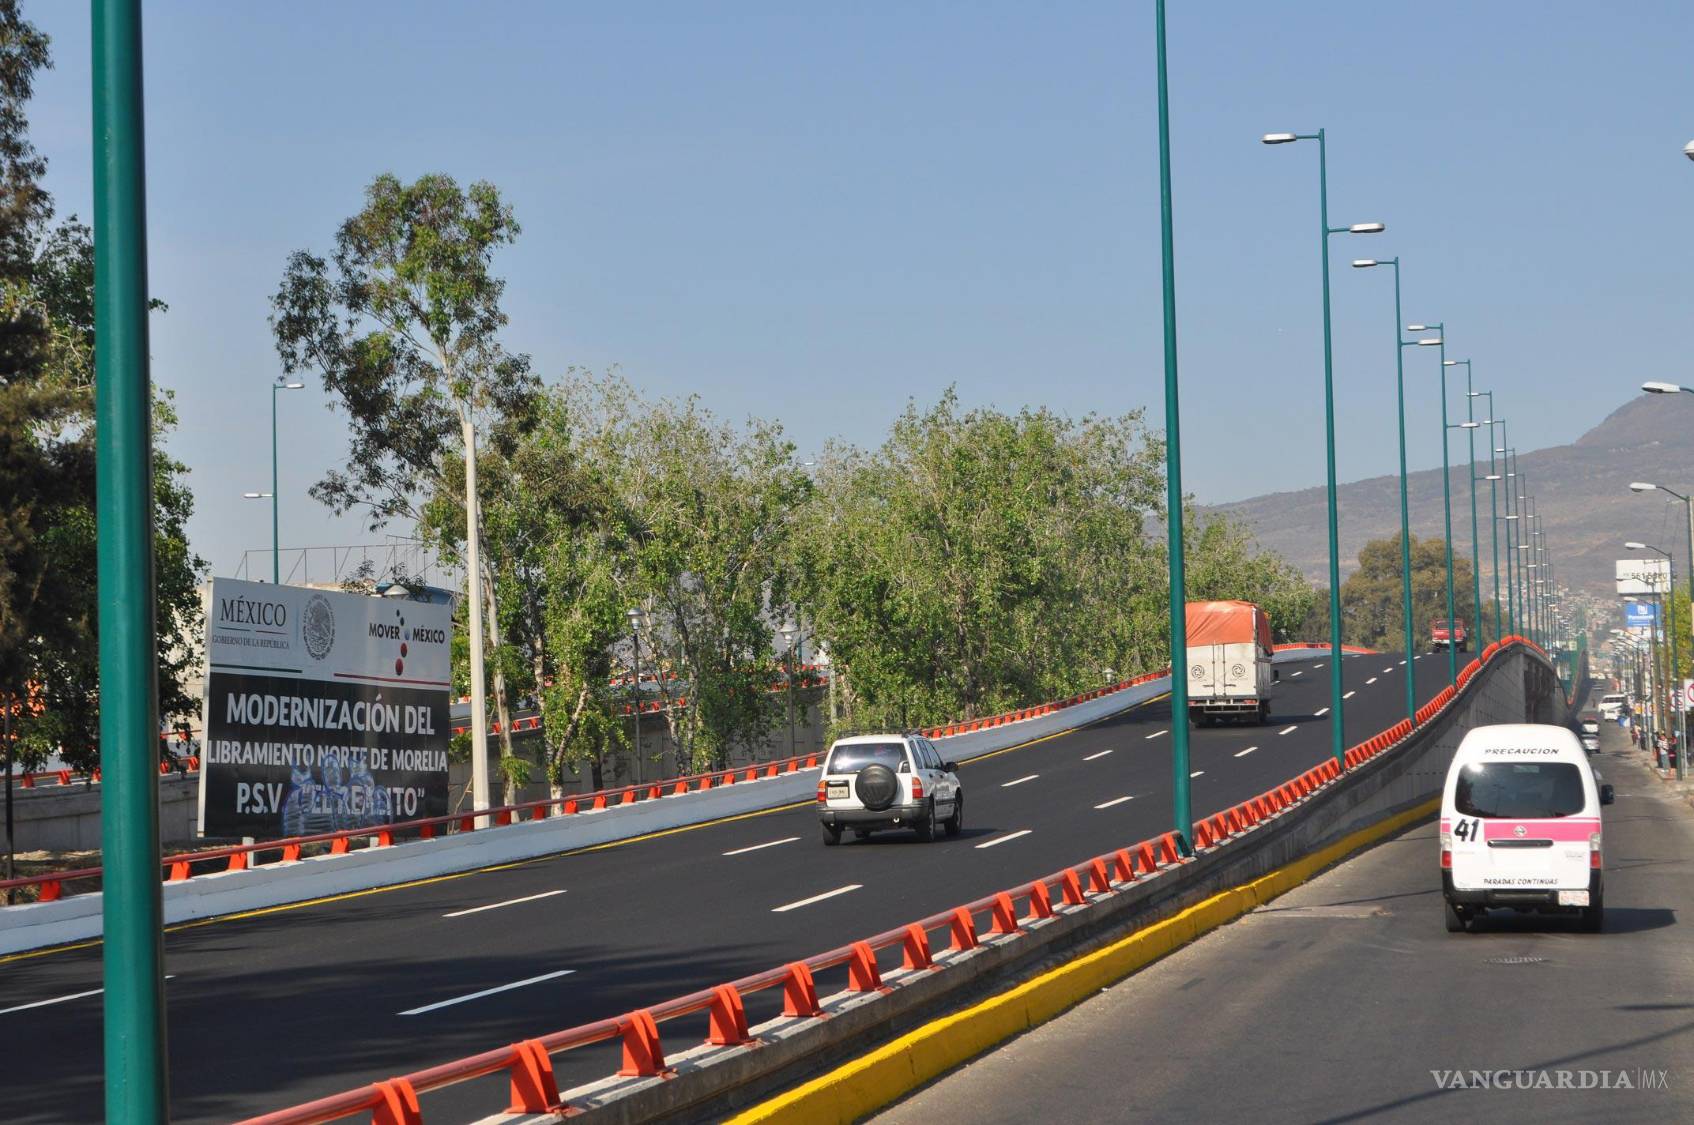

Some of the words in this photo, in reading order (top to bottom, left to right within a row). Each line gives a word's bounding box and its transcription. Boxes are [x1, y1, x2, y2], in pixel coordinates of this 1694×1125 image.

[220, 595, 287, 627] MÉXICO
[212, 634, 242, 645] GOBIERNO
[243, 637, 251, 647] DE
[252, 639, 259, 648] LA
[368, 623, 400, 640] MOVER
[412, 625, 445, 644] MÉXICO
[226, 692, 400, 733] MODERNIZACIÓN
[404, 705, 435, 735] DEL
[207, 740, 315, 767] LIBRAMIENTO
[317, 744, 368, 767] NORTE
[370, 749, 389, 770] DE
[392, 750, 448, 772] MORELIA
[1454, 818, 1480, 842] 41
[1484, 878, 1515, 886] PARADAS
